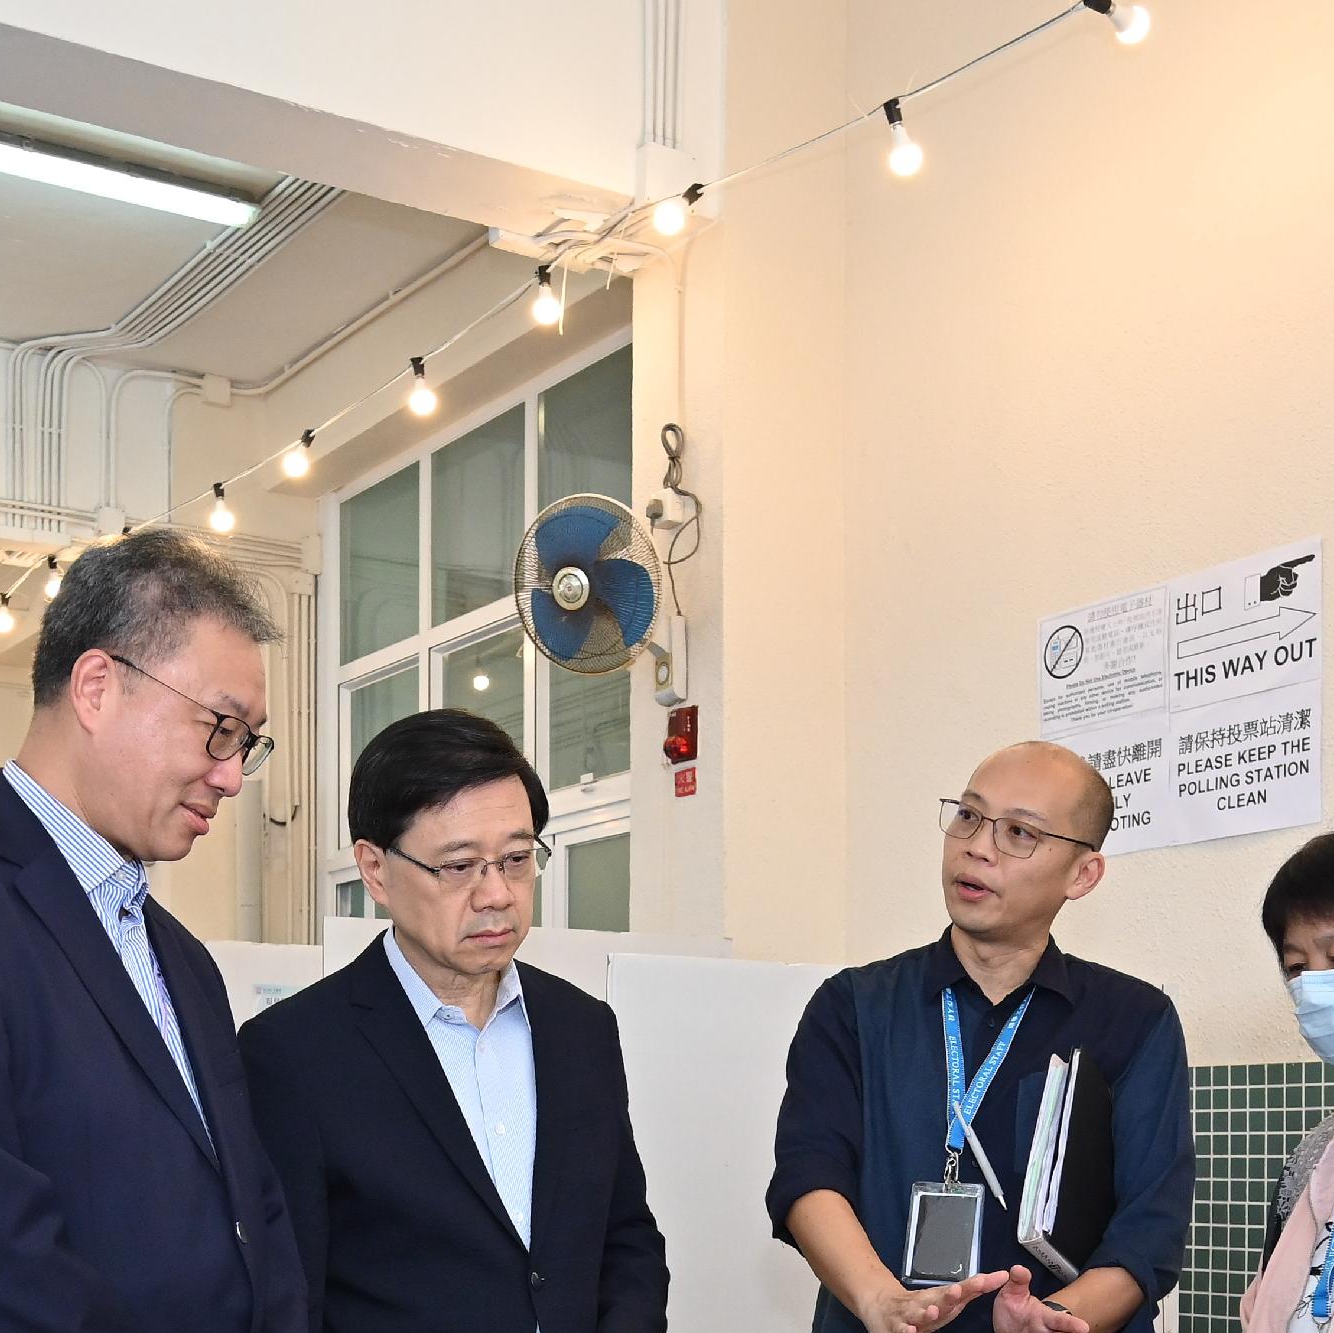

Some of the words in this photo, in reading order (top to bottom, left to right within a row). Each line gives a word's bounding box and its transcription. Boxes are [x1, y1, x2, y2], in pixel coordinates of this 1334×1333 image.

[1175, 585, 1222, 625] 出口
[1174, 664, 1216, 691] THIS
[1222, 651, 1267, 682] WAY
[1273, 638, 1317, 666] OUT
[1178, 708, 1311, 757] 請保持投票站清潔
[1081, 738, 1162, 771] 請盡快離開
[1178, 752, 1232, 777] PLEASE
[1238, 744, 1276, 769] KEEP
[1281, 736, 1311, 755] THE
[1109, 768, 1152, 789] LEAVE
[1179, 769, 1240, 797] POLLING
[1245, 759, 1309, 786] STATION
[1217, 789, 1267, 811] CLEAN
[1110, 811, 1151, 831] OTING
[949, 1035, 960, 1087] ELECTORAL
[964, 1064, 993, 1115] ELECTORAL
[991, 1041, 1006, 1066] STAFF
